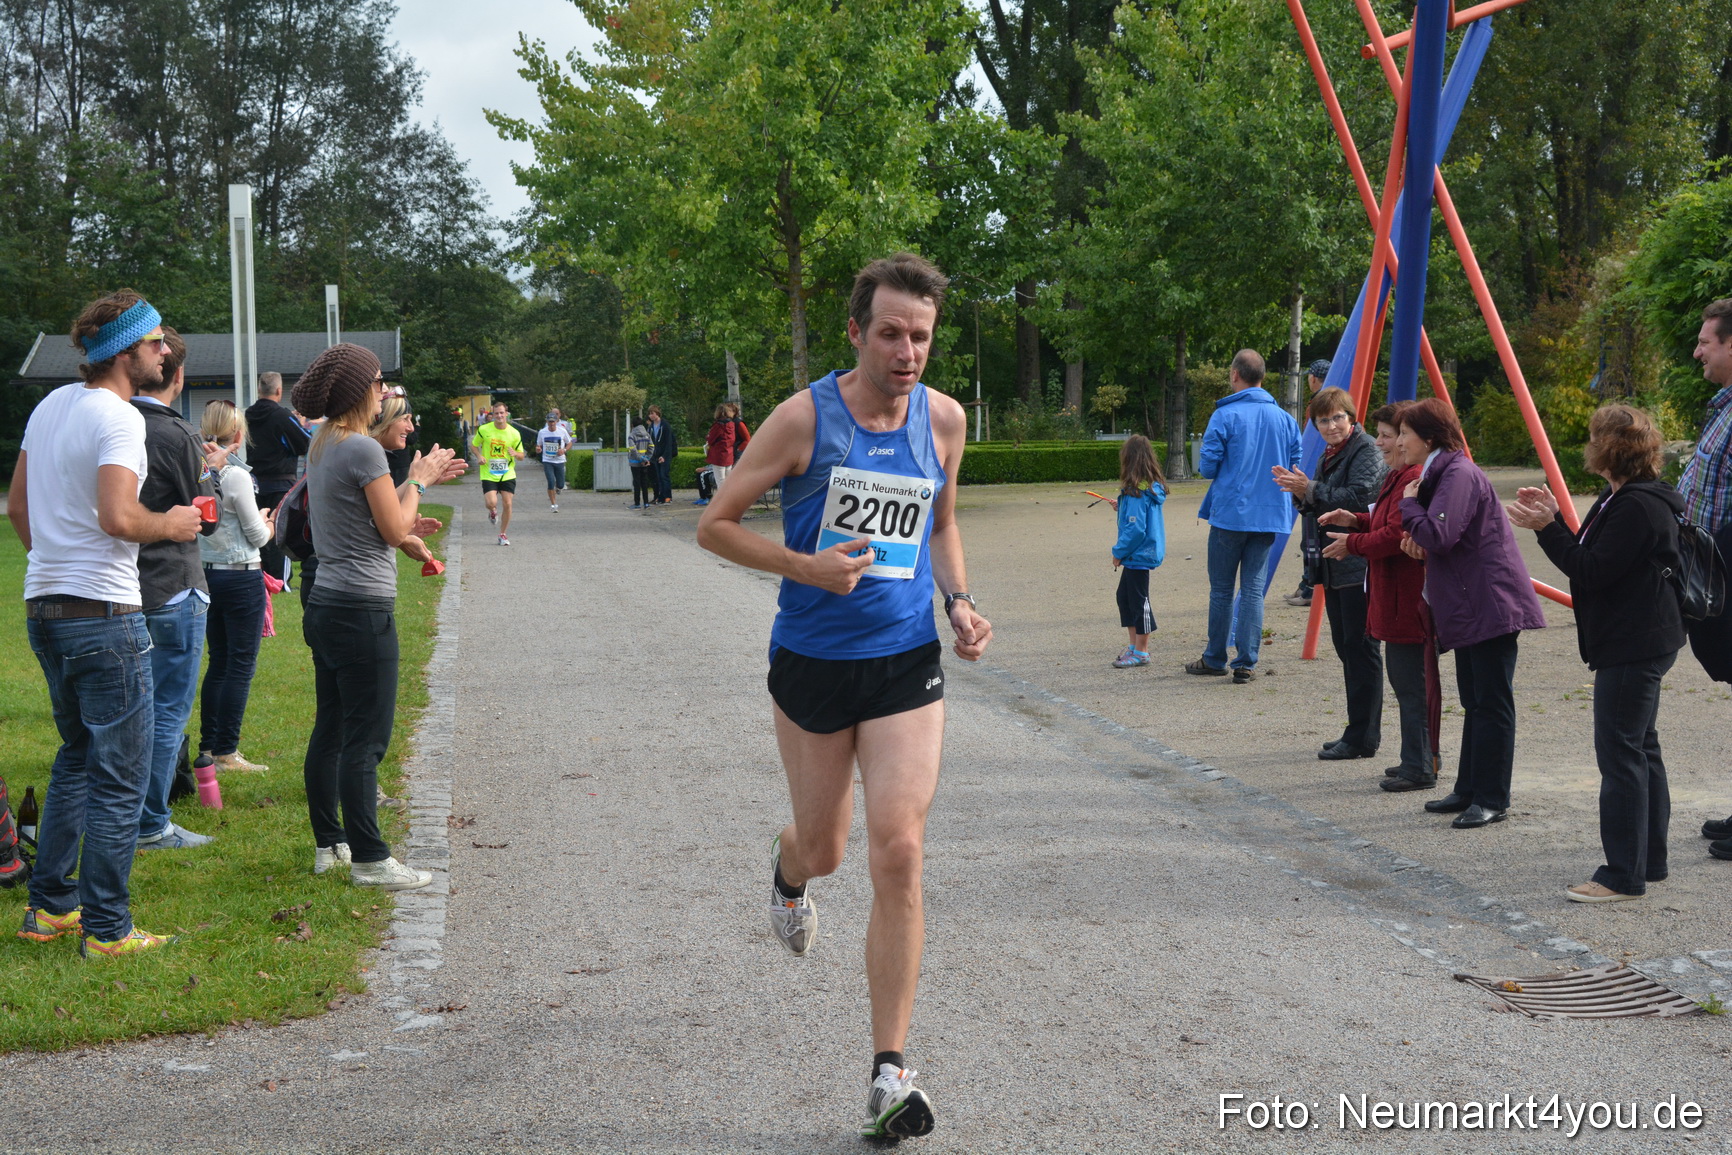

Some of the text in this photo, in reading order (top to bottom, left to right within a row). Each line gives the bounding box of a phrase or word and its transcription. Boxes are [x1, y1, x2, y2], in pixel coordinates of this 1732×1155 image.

[876, 448, 895, 456] asics
[832, 477, 918, 497] PARTL Neumarkt
[834, 494, 920, 538] 2200
